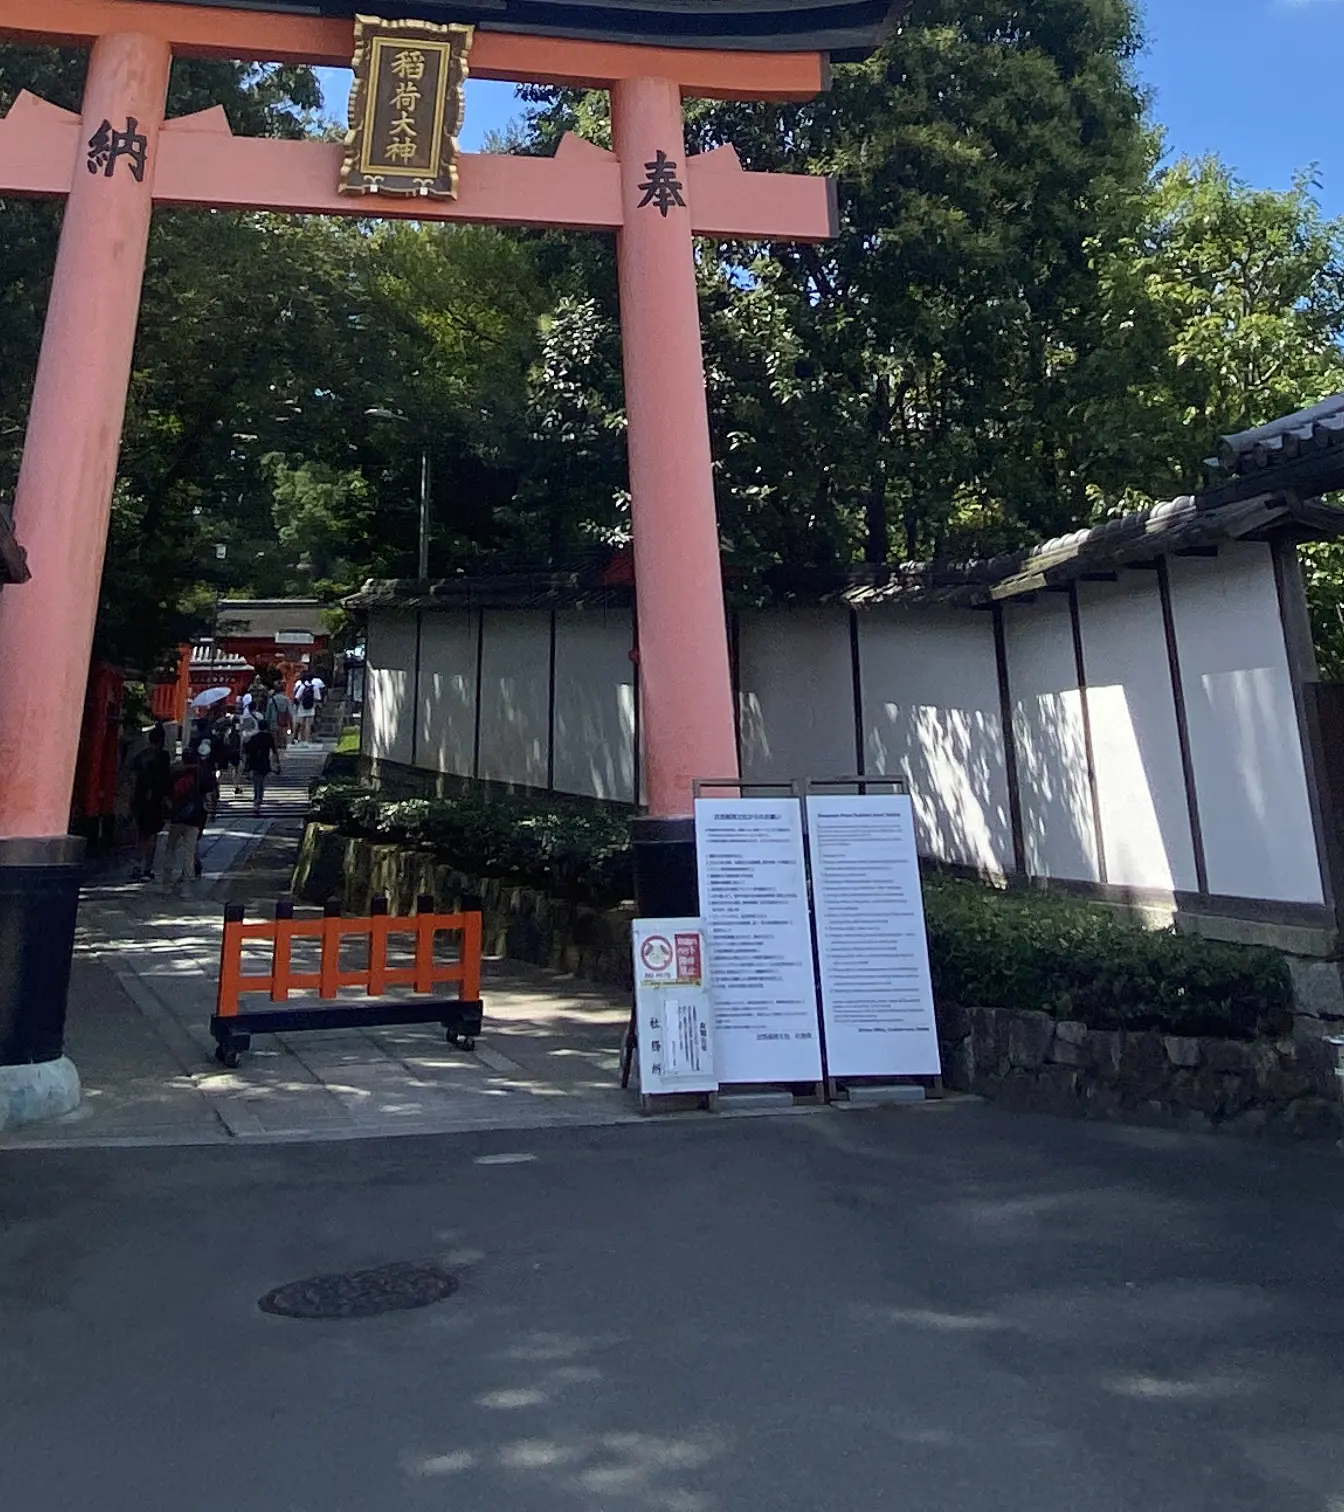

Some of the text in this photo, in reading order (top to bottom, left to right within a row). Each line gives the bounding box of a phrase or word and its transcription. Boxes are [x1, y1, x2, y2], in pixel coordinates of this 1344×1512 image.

[384, 50, 425, 165] 稲荷大神
[87, 116, 148, 182] 納
[637, 149, 687, 218] 奉
